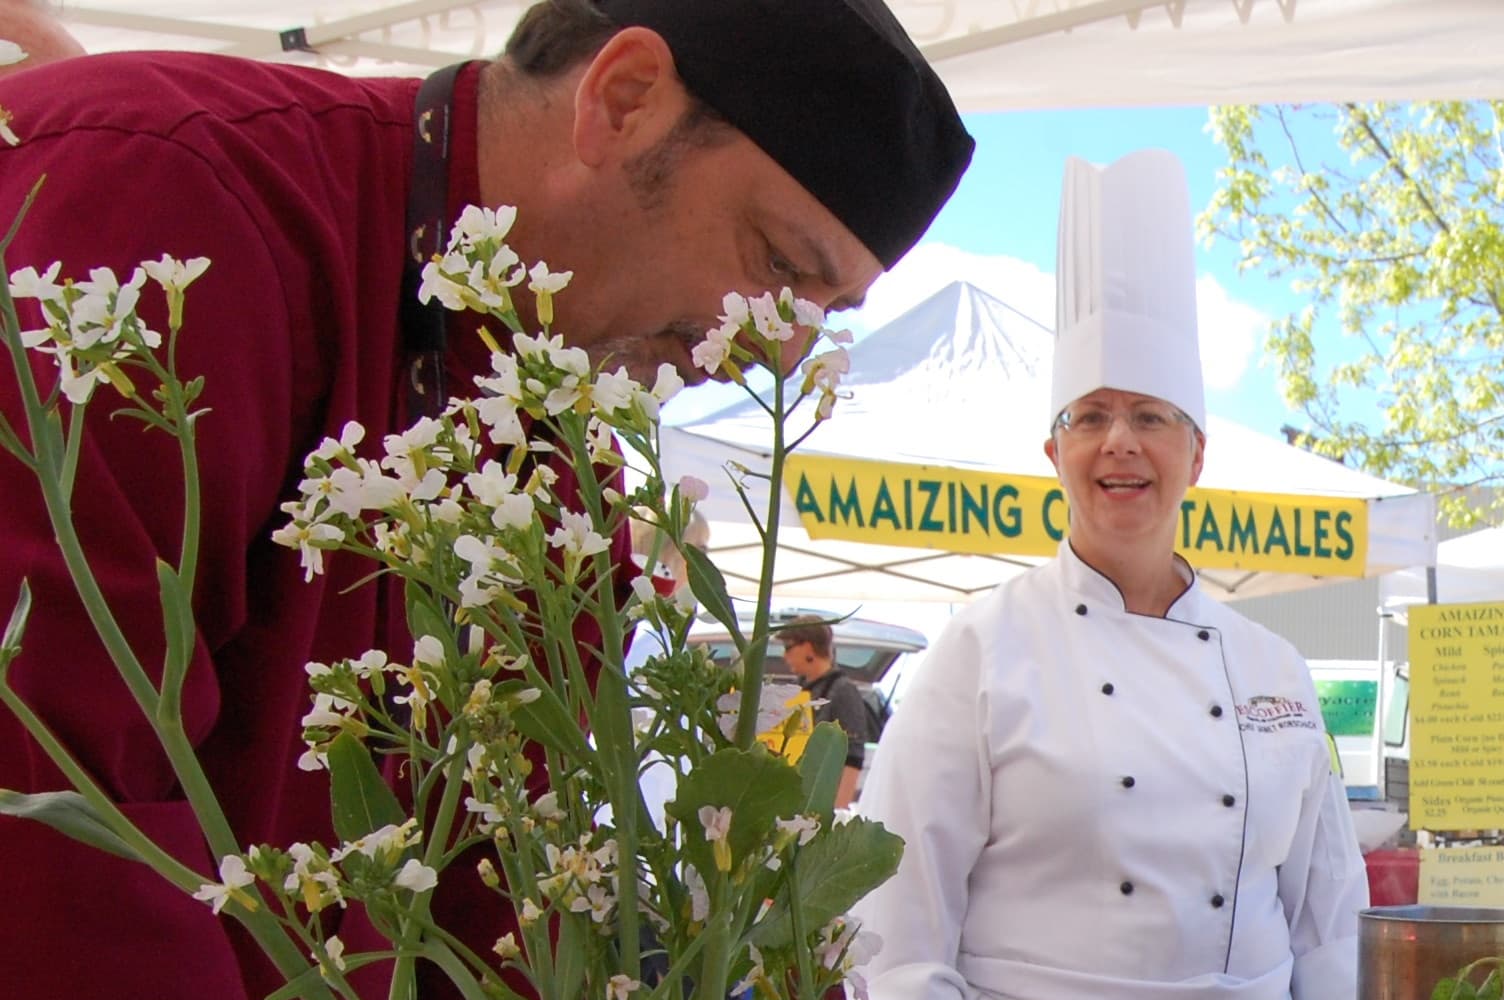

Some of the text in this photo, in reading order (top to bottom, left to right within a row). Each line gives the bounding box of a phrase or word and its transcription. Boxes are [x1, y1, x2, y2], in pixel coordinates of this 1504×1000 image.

[795, 471, 1023, 538] AMAIZING
[1181, 499, 1355, 561] TAMALES
[1420, 626, 1462, 640] CORN
[1435, 646, 1462, 657] Mild
[1438, 851, 1492, 864] Breakfast
